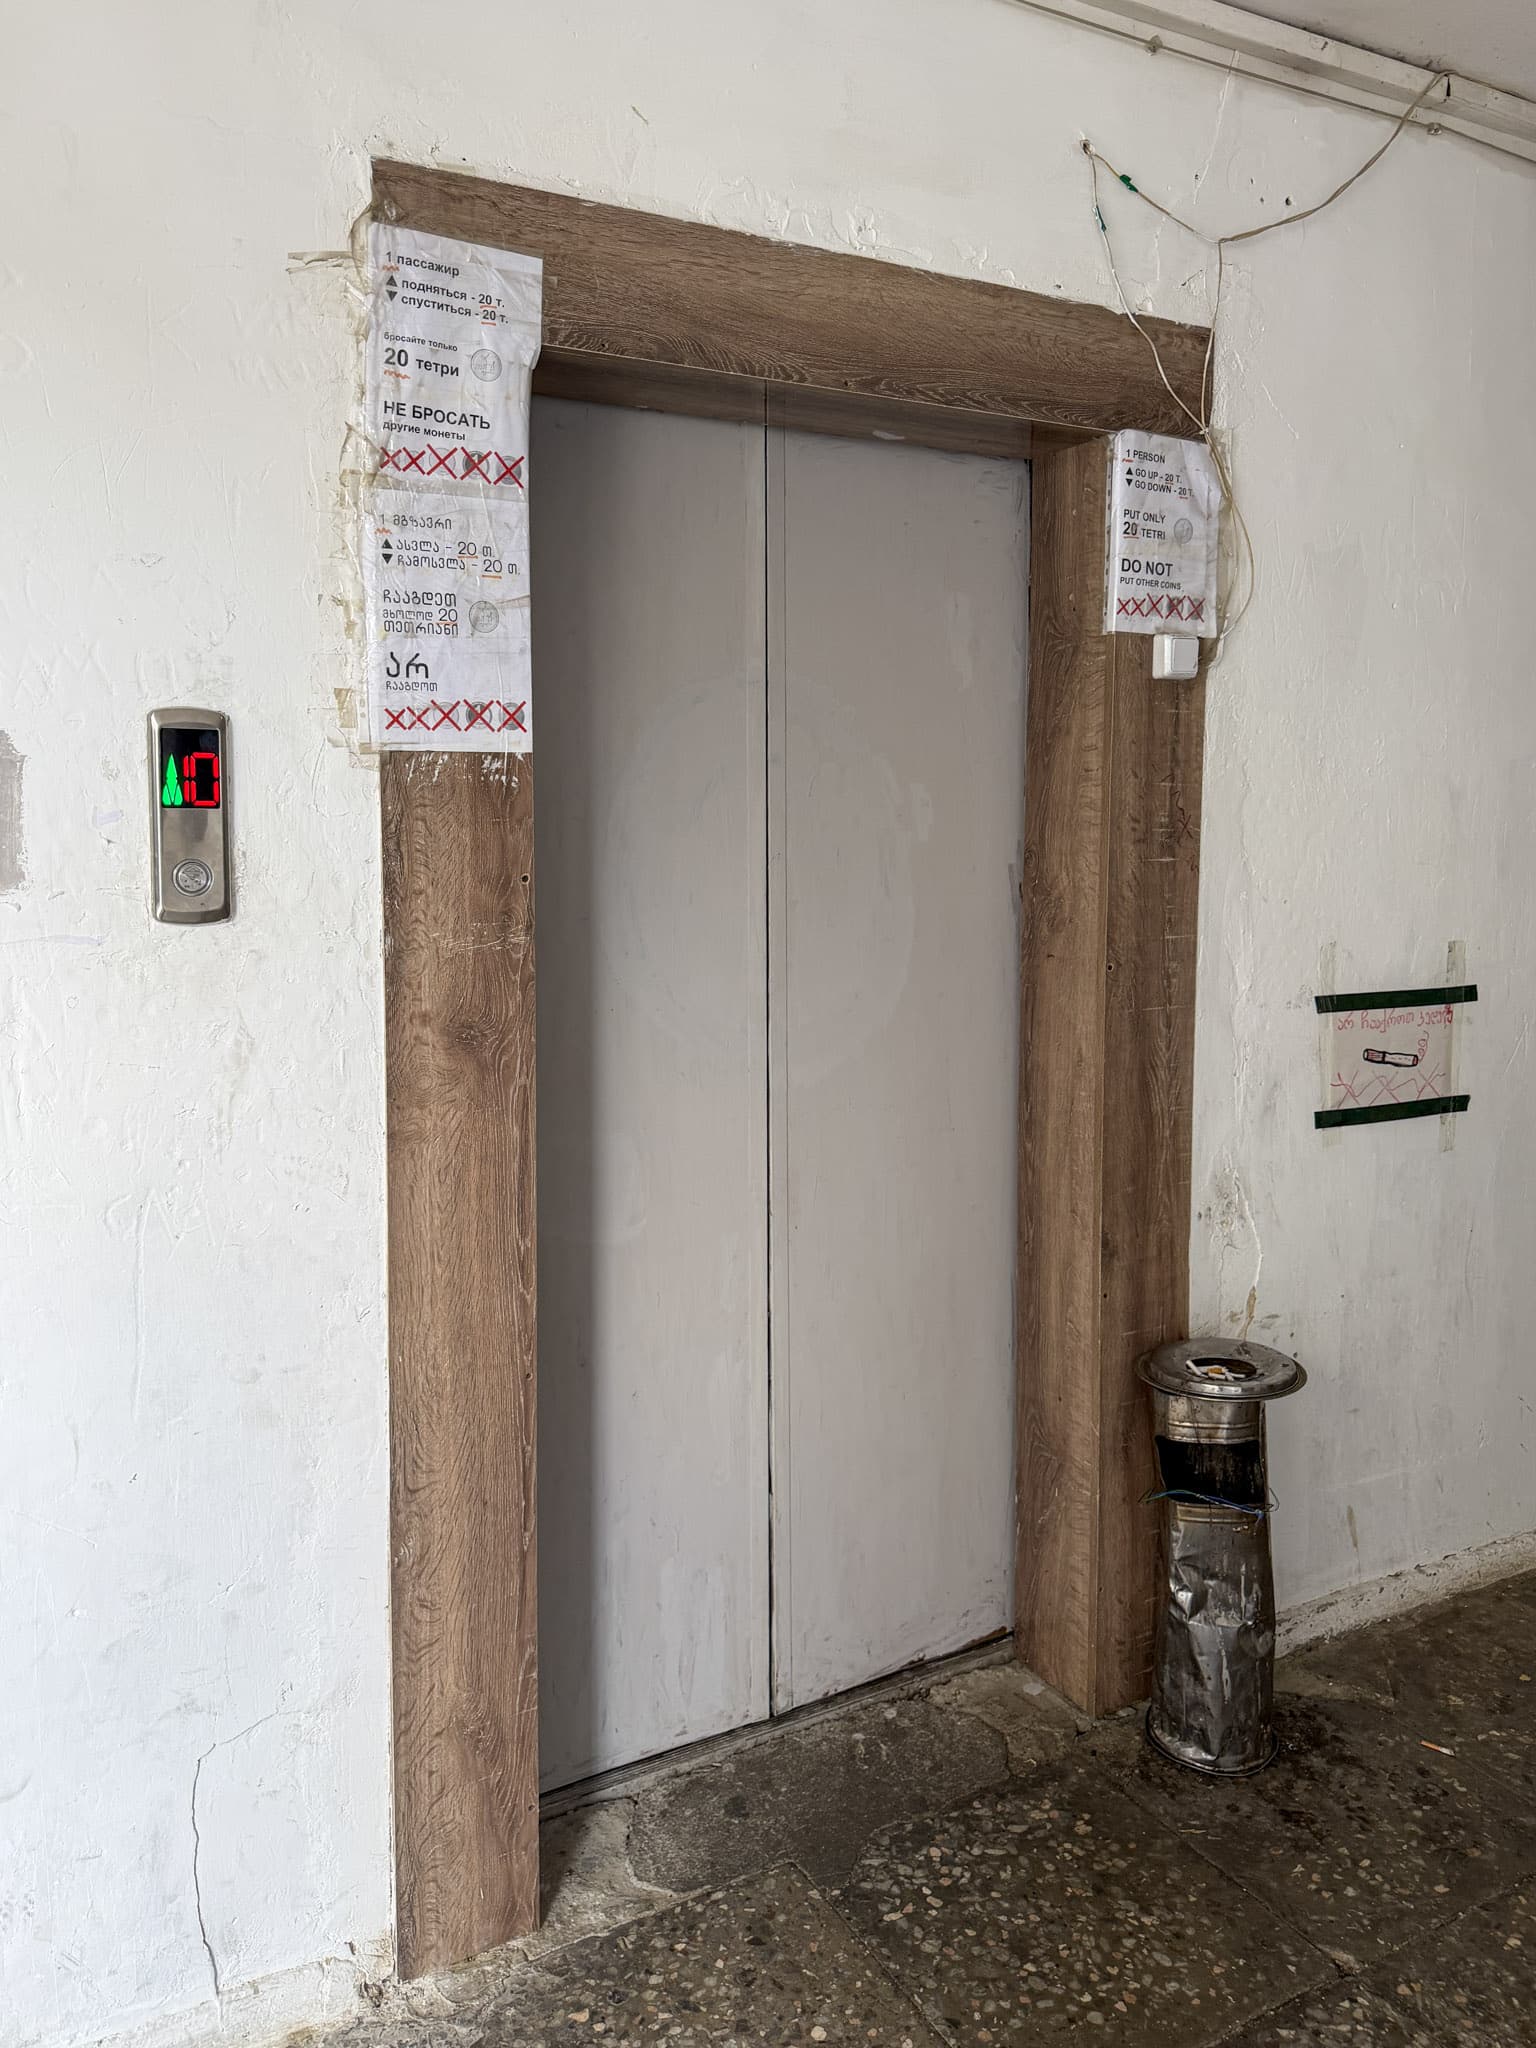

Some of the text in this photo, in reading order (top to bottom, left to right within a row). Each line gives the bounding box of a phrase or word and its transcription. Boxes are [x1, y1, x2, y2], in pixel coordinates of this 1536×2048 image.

[385, 251, 460, 278] 1 пассажир
[401, 279, 467, 301] подняться
[478, 293, 493, 306] 20
[495, 298, 506, 308] т.
[401, 294, 472, 317] спуститься
[482, 309, 497, 321] 20
[499, 313, 510, 324] т.
[383, 331, 458, 352] бросайте только
[383, 347, 460, 378] 20 тетри
[383, 400, 491, 430] НЕ БРОСАТЬ
[383, 421, 466, 441] другие монеты
[1132, 450, 1166, 464] PERSON
[1135, 468, 1147, 478] GO
[1148, 470, 1159, 480] UP
[1165, 473, 1174, 482] 20
[1135, 480, 1146, 490] GO
[1147, 482, 1172, 494] DOWN
[1178, 487, 1187, 496] 20
[393, 514, 452, 530] მგზავრი
[1123, 508, 1166, 524] PUT ONLY
[1123, 521, 1166, 540] 20 TETRI
[396, 539, 440, 553] ასვლა
[457, 541, 477, 556] 20
[397, 554, 466, 570] ჩამოსვლა
[483, 559, 503, 574] 20
[1121, 558, 1173, 577] DO NOT
[1120, 576, 1135, 586] PUT
[1135, 578, 1159, 588] OTHER
[383, 589, 457, 607] ჩააგდეთ
[382, 608, 458, 622] მხოლოდ 20
[383, 620, 459, 636] თეთრიანი
[386, 651, 429, 679] არ
[386, 680, 438, 692] ჩააგდოთ
[183, 752, 220, 807] 10
